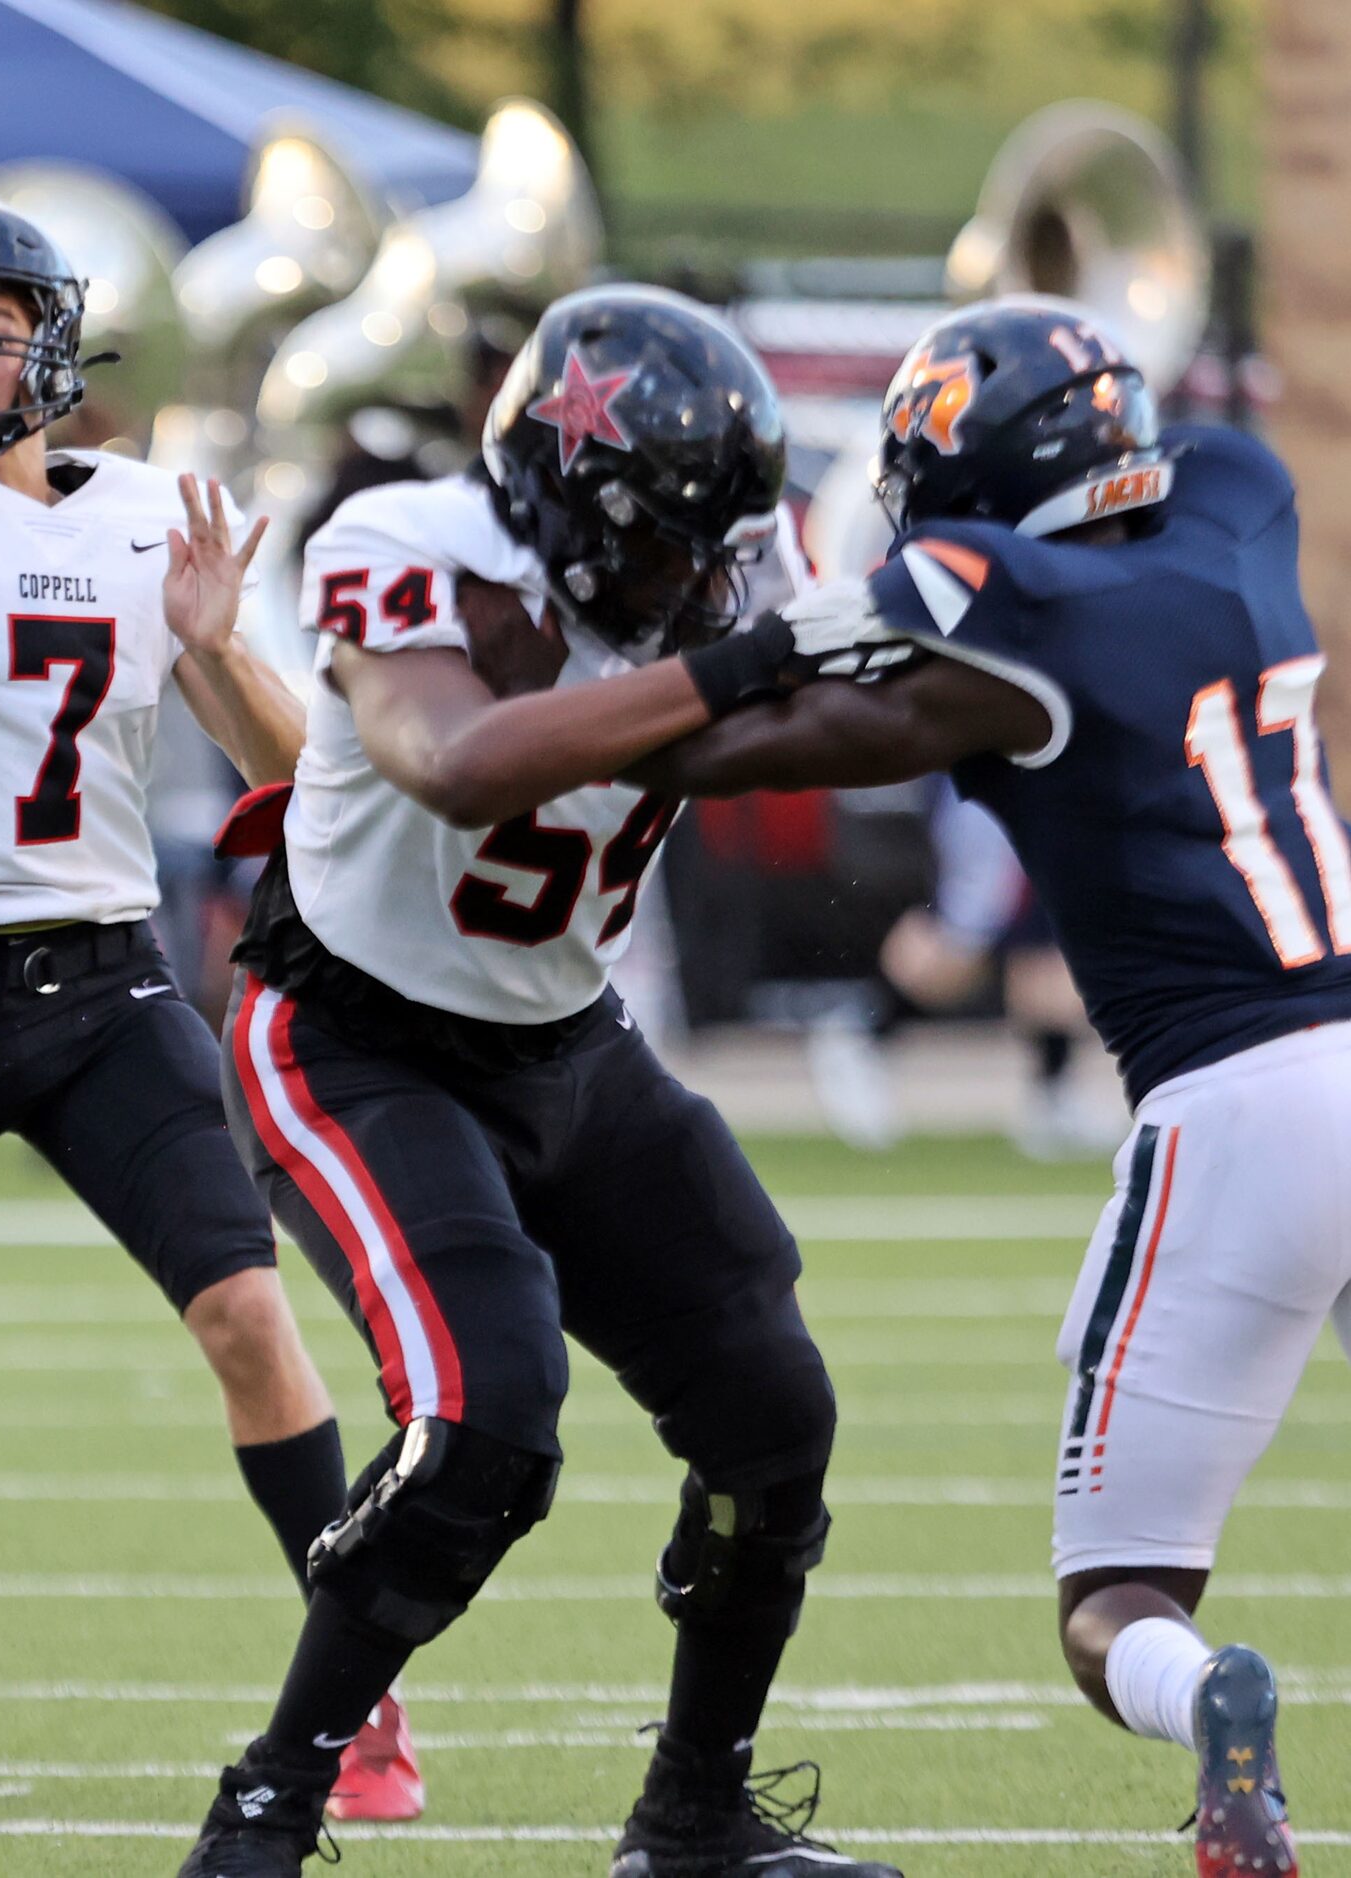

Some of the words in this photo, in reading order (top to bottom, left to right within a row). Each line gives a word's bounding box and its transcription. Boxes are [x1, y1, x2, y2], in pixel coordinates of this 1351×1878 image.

[19, 573, 97, 603] COPPELL
[318, 566, 437, 648] 54
[7, 613, 116, 846] 7
[1184, 654, 1351, 971] 17
[448, 780, 688, 950] 54
